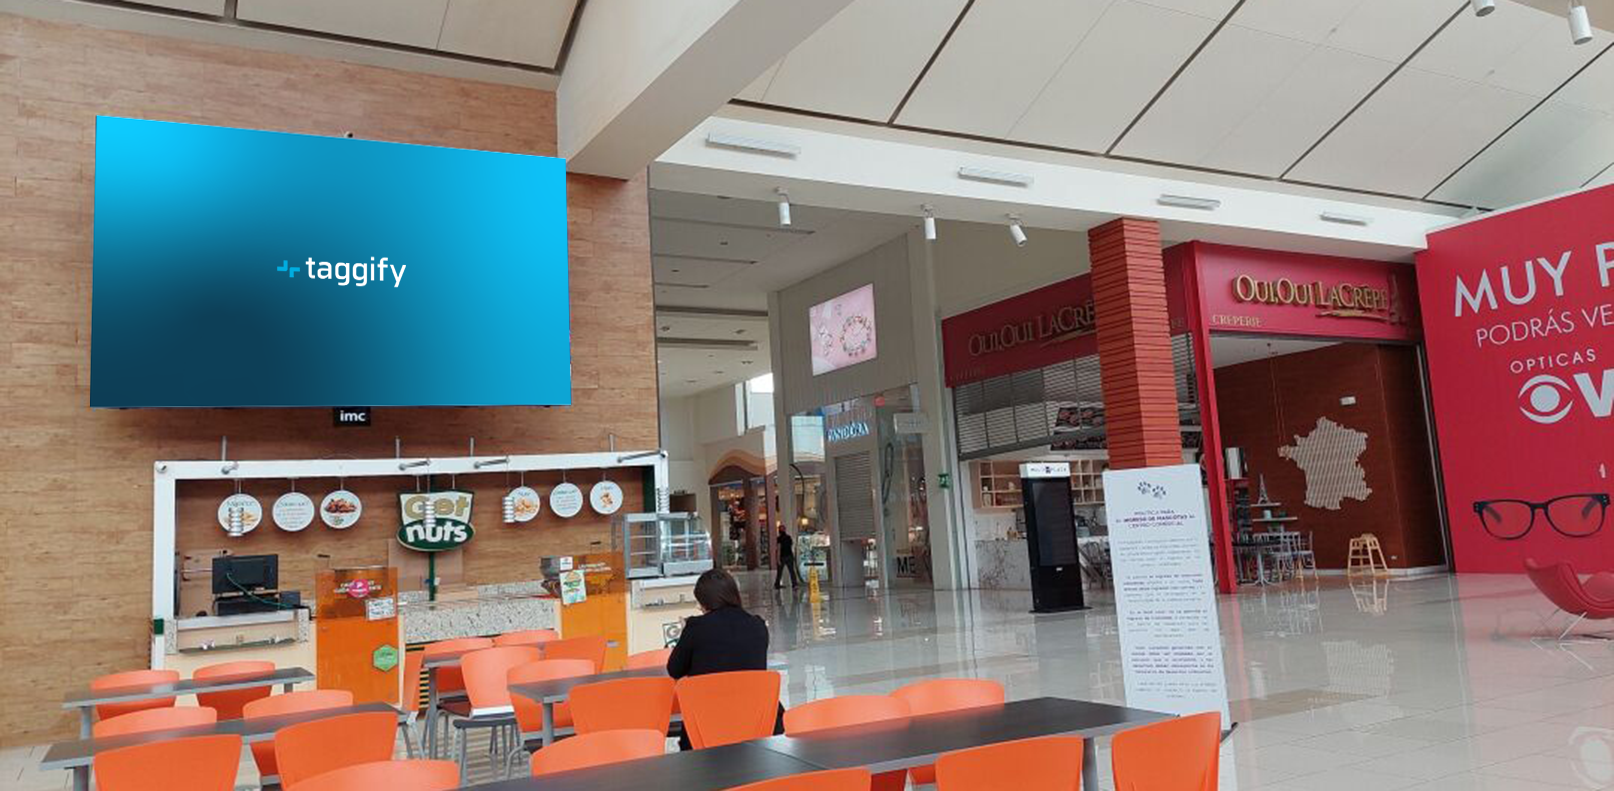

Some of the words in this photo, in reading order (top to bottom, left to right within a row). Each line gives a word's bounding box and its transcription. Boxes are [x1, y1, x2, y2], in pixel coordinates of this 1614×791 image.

[305, 256, 407, 288] taggify
[1454, 251, 1571, 317] MUY
[1476, 308, 1575, 348] PODRÁS
[1510, 348, 1597, 374] OPTICAS
[339, 409, 366, 422] imc
[405, 522, 469, 543] nuts
